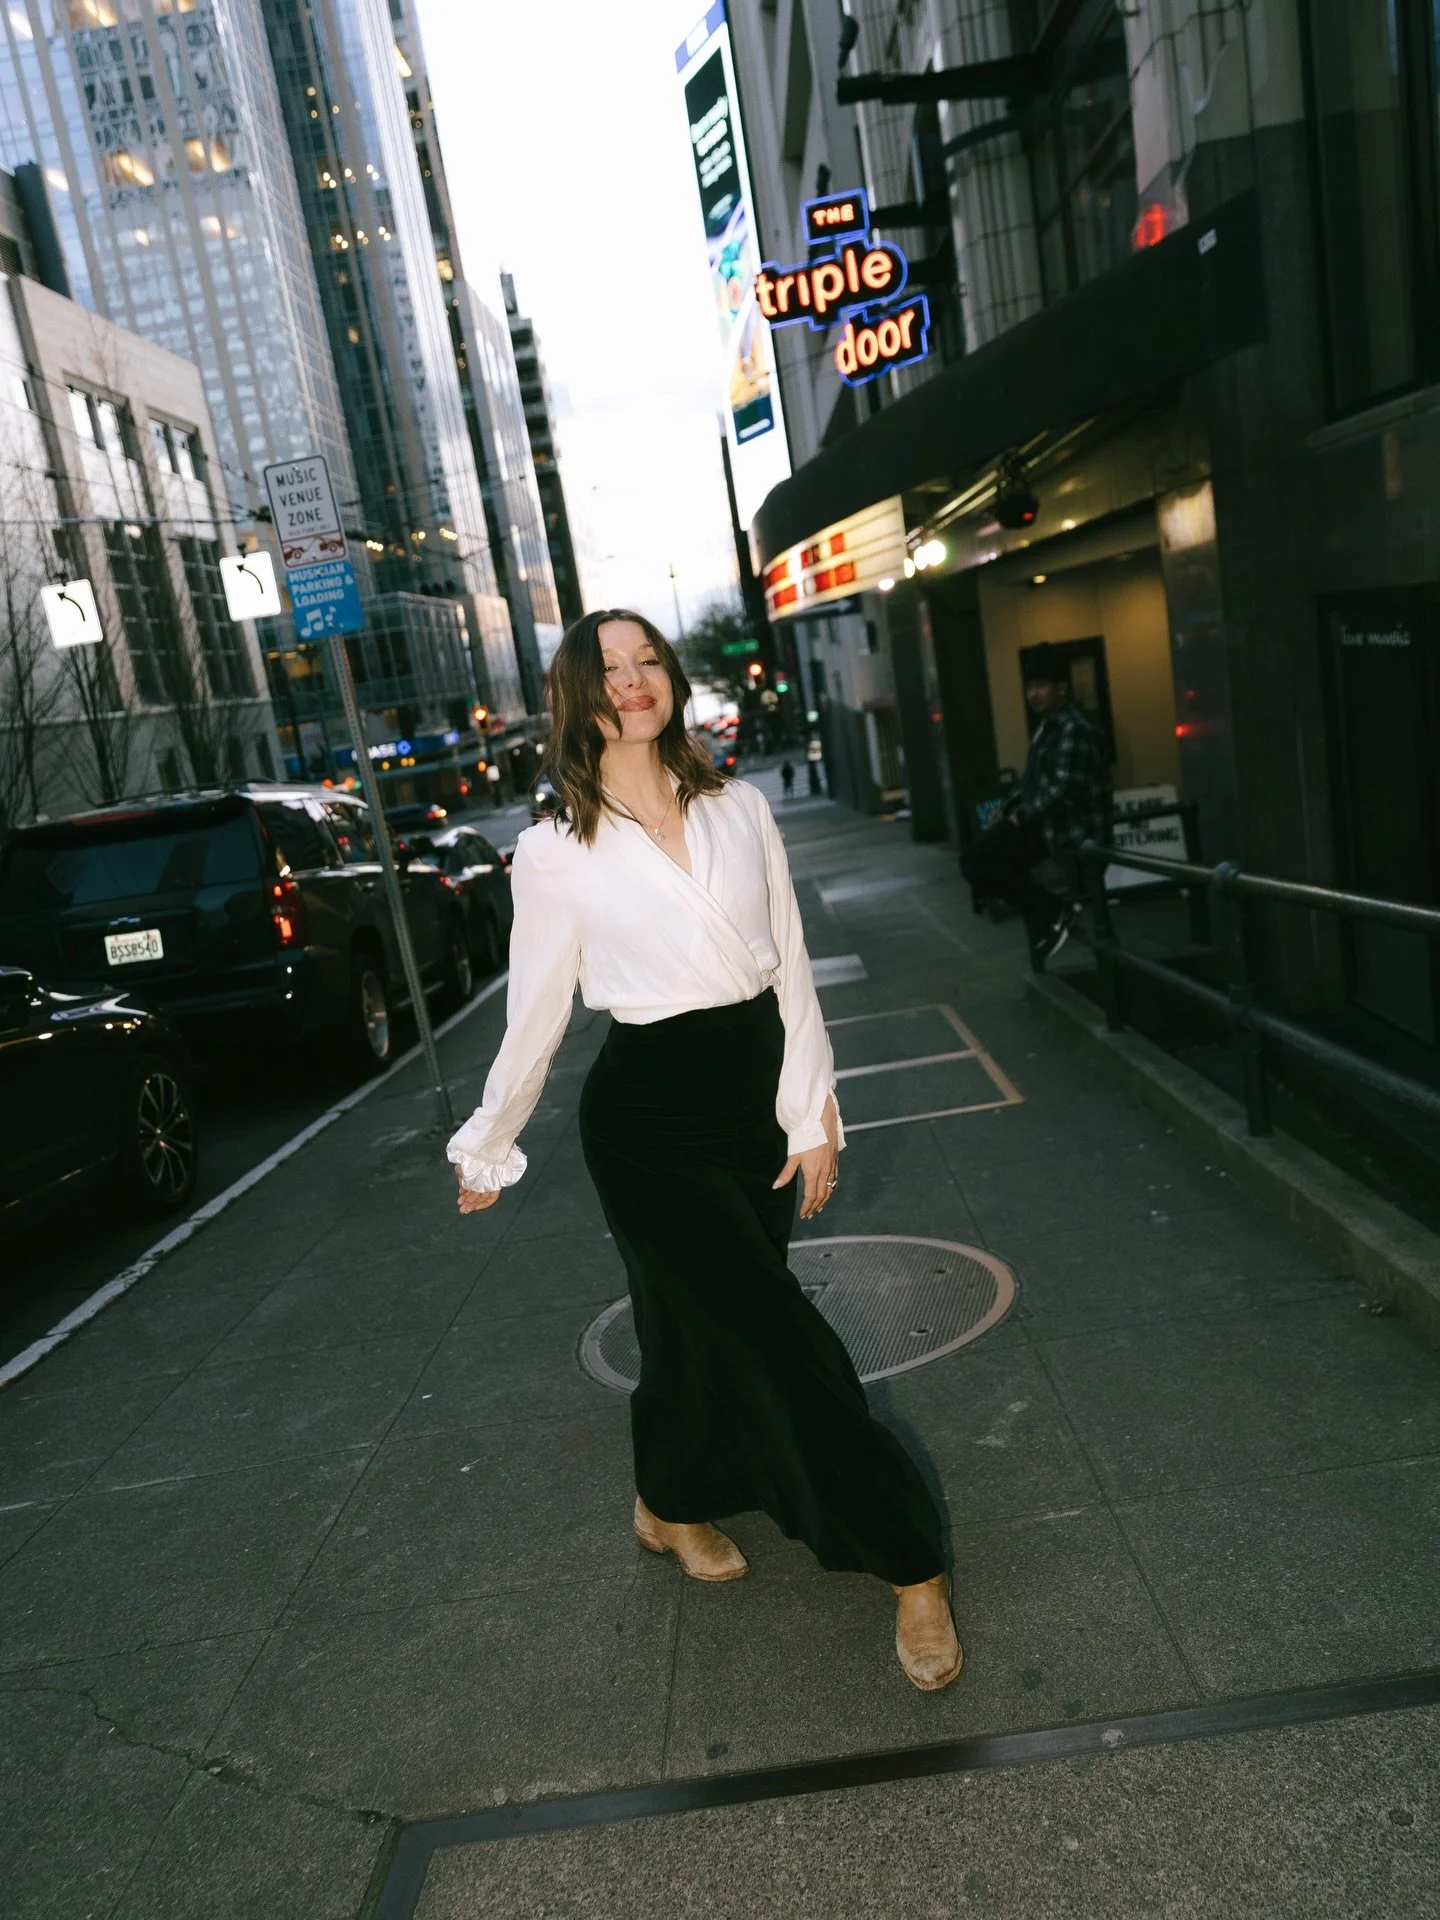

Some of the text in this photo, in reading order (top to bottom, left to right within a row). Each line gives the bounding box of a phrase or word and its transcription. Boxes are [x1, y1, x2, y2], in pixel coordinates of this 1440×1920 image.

[813, 203, 855, 227] THE
[755, 247, 893, 317] triple
[835, 308, 915, 376] door
[276, 467, 317, 487] MUSIC
[279, 487, 323, 508] VENUE
[288, 507, 323, 527] ZONE
[290, 562, 345, 583] MUSICIAN
[291, 574, 354, 596] PARKING &
[295, 589, 344, 608] LOADING
